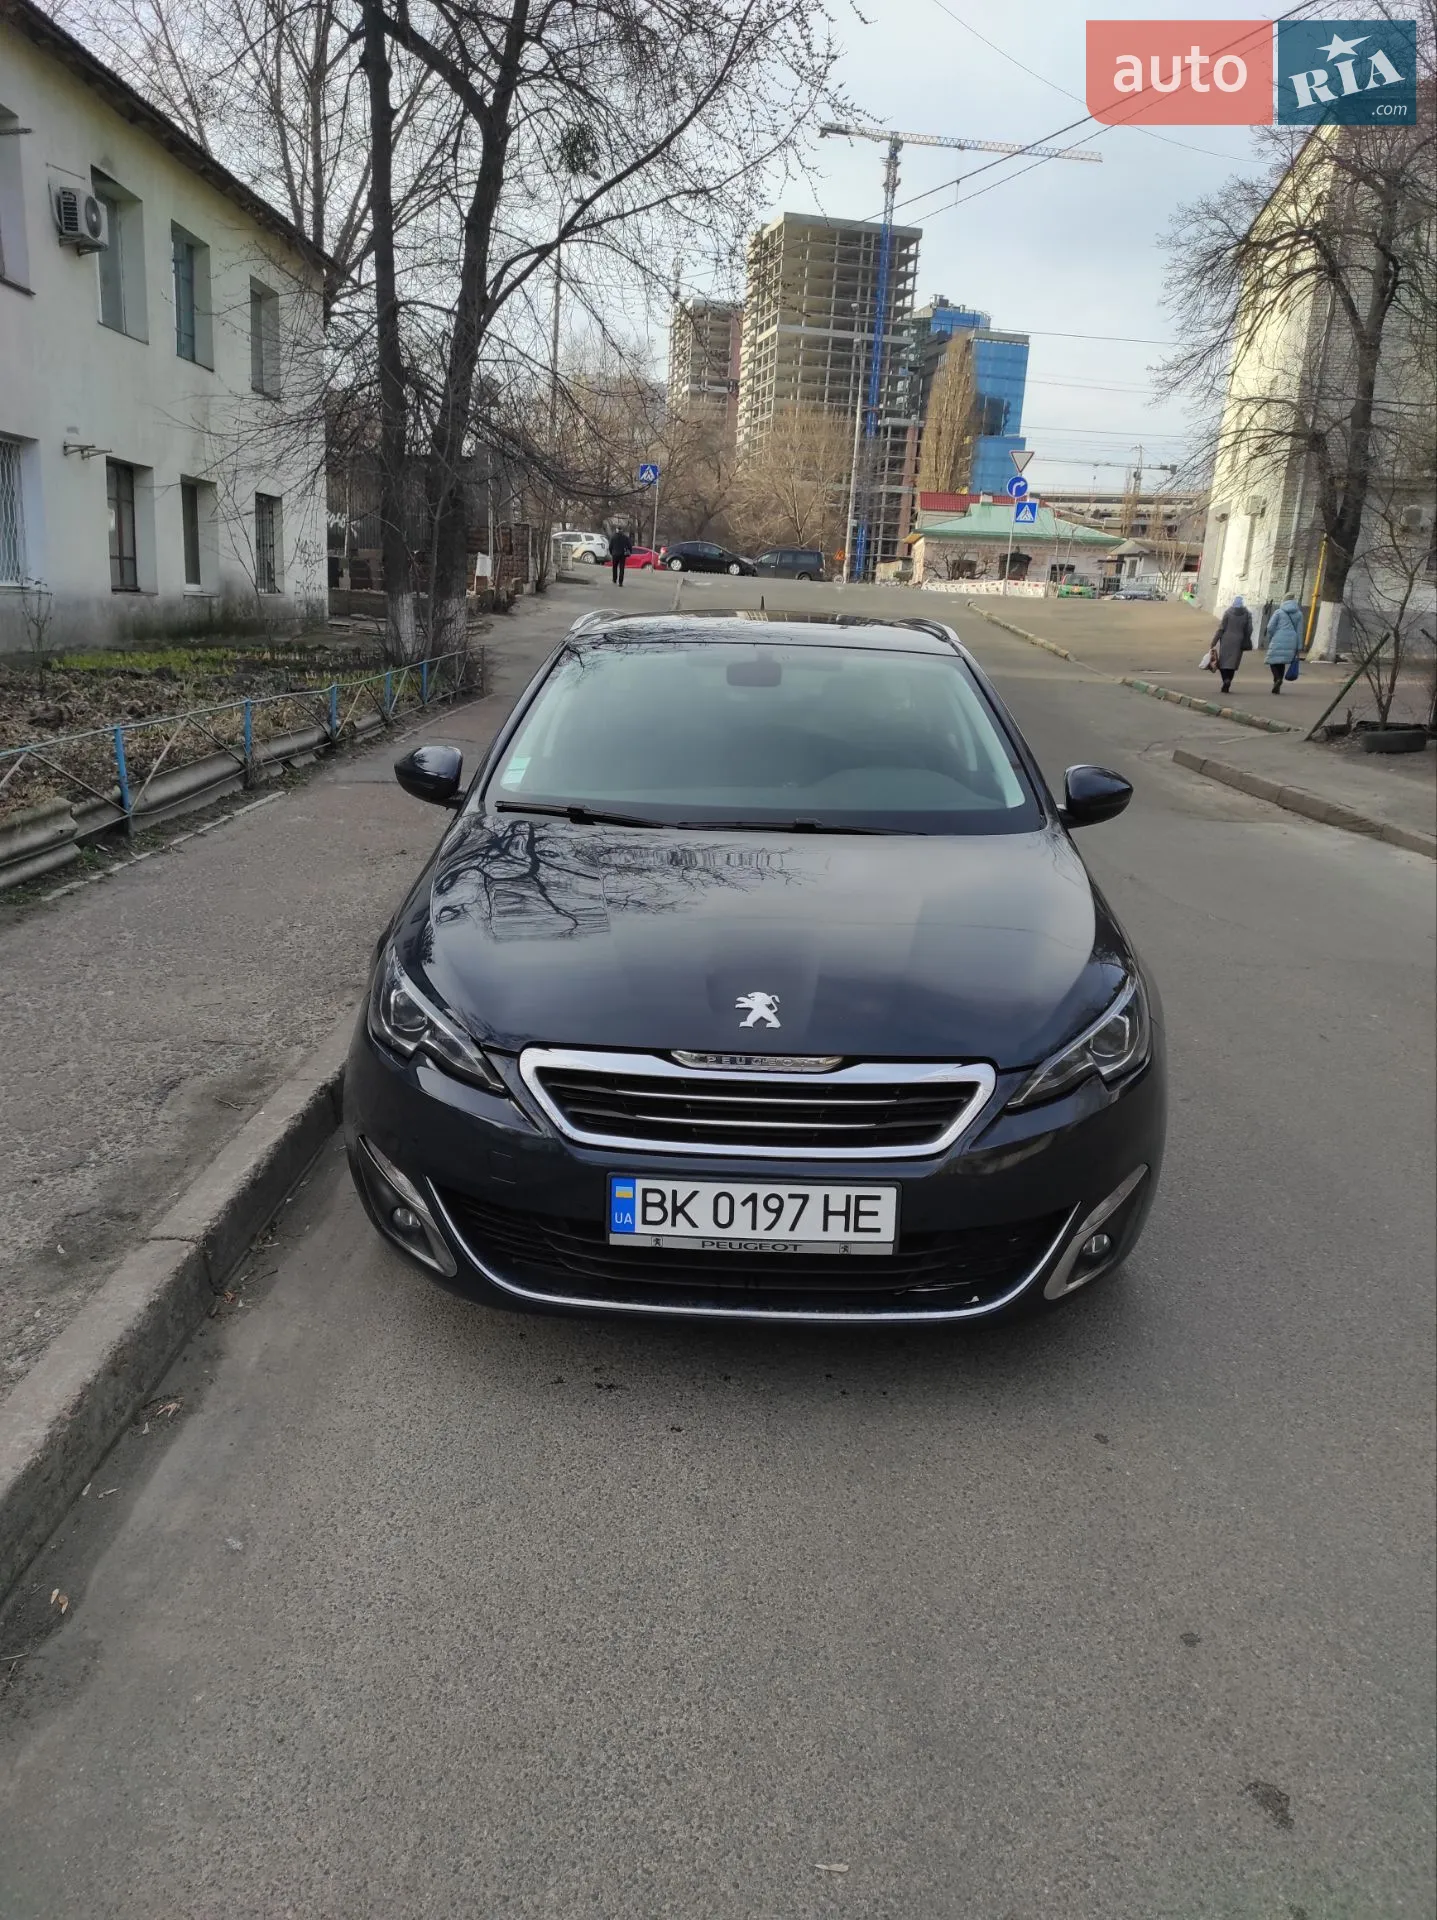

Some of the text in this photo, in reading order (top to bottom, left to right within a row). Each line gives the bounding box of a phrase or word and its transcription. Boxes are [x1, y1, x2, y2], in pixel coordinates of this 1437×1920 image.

[641, 1187, 882, 1233] BK 0197 HE
[614, 1212, 633, 1225] UA
[701, 1240, 803, 1252] PEUGEOT
